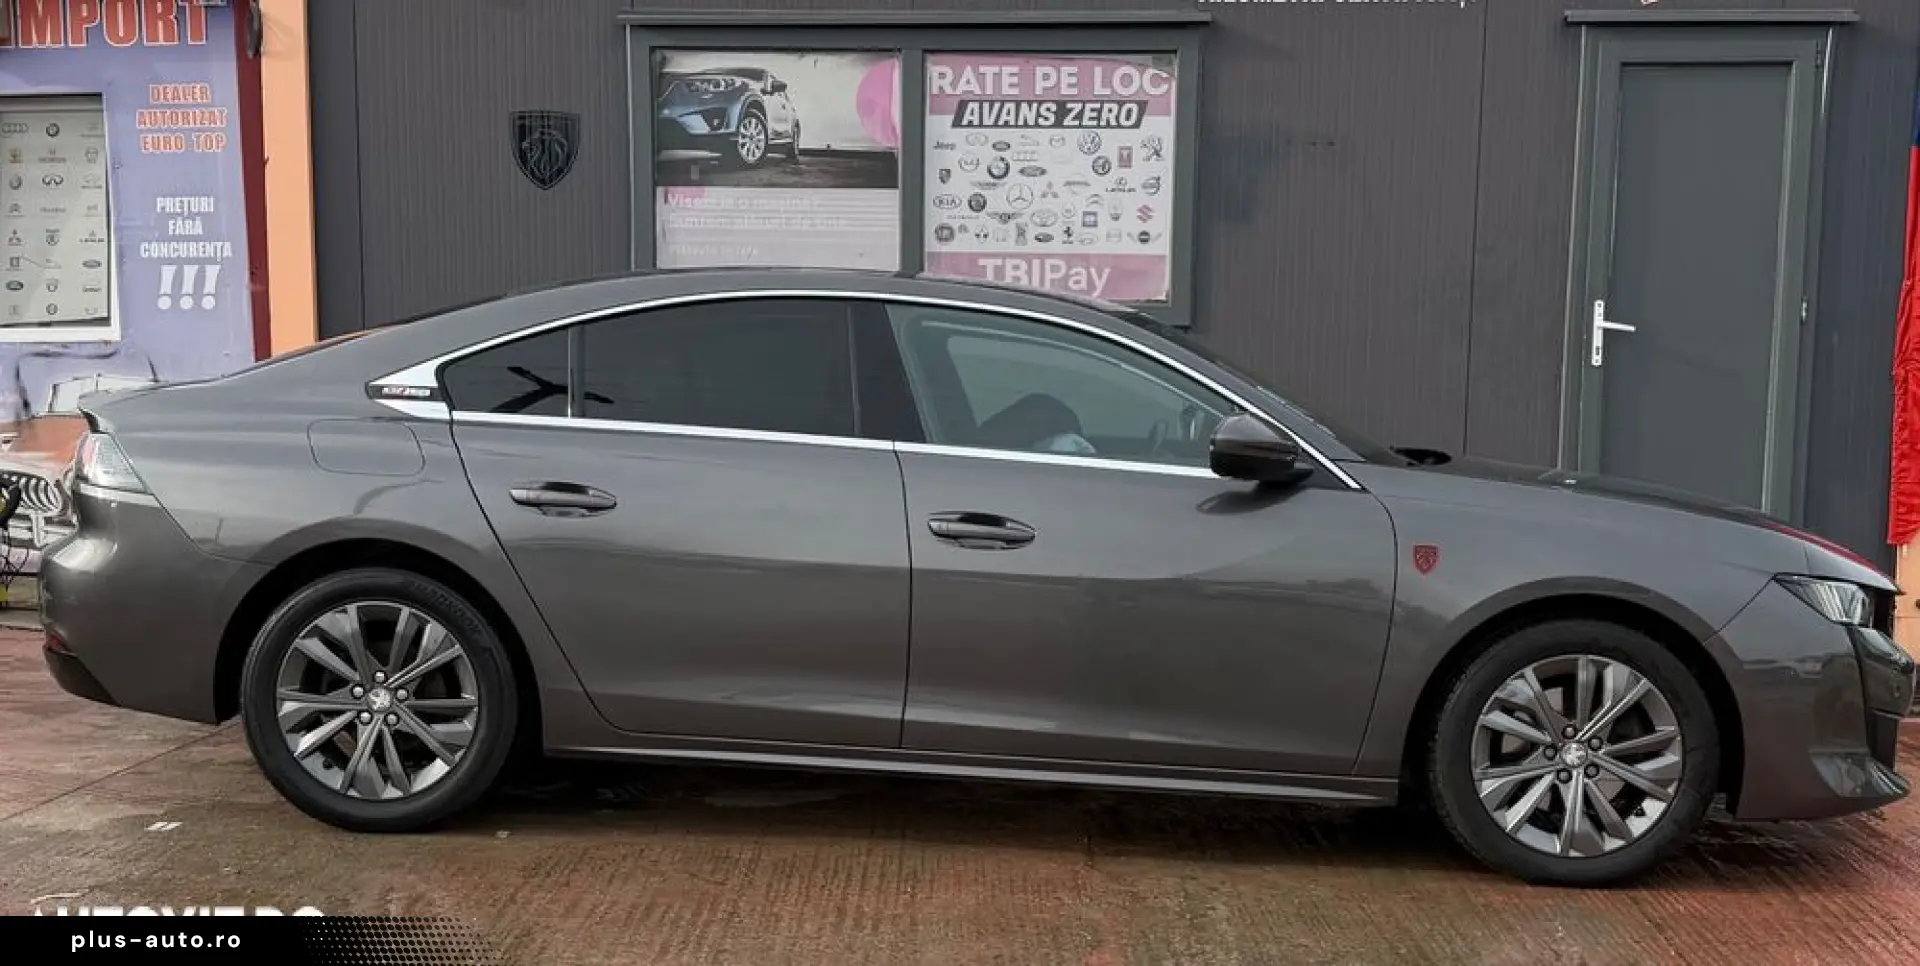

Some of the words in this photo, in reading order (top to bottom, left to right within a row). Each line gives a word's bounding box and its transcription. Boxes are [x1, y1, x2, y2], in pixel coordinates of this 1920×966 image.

[930, 64, 1020, 96] RATE
[1034, 65, 1078, 96] PE
[1093, 66, 1170, 96] LOC
[150, 83, 212, 104] DEALER
[136, 107, 228, 129] AUTORIZAT
[960, 101, 1057, 127] AVANS
[1062, 101, 1141, 127] ZERO
[141, 132, 184, 153] EURO
[192, 132, 227, 152] TOP
[933, 139, 956, 151] Jeep
[157, 264, 222, 310] !!!
